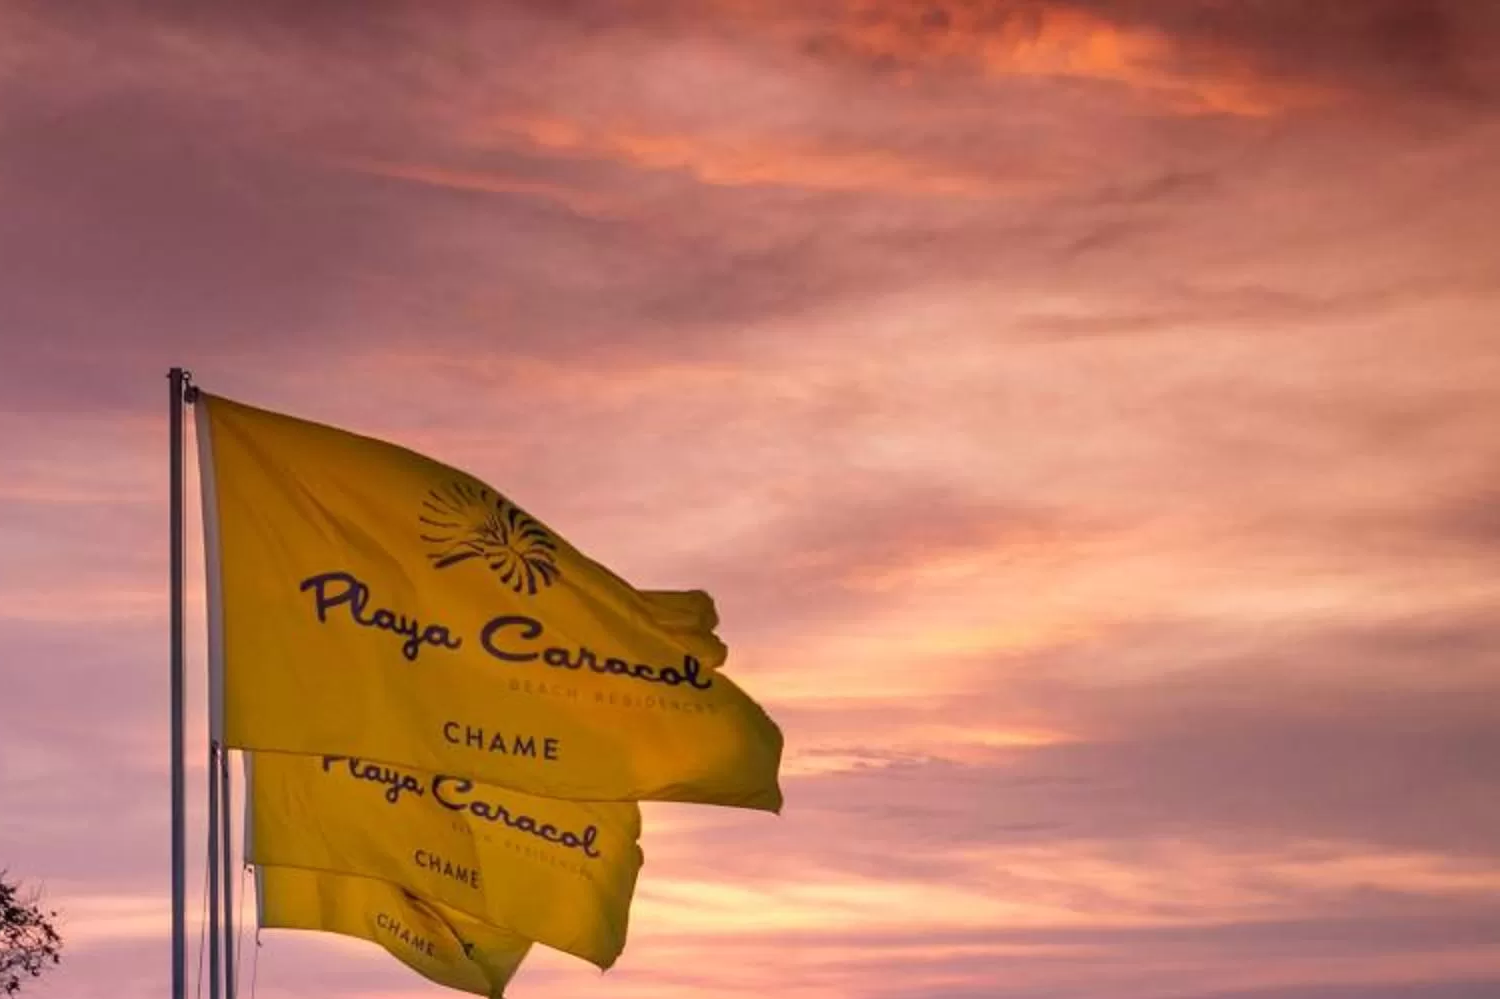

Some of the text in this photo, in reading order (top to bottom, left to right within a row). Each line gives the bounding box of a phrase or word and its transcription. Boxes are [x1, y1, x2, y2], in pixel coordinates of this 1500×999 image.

[301, 572, 713, 690] Playa Caracol
[508, 678, 578, 699] BEACH
[443, 721, 560, 762] CHAME
[432, 774, 600, 858] Caracol
[414, 849, 480, 890] CHAME
[376, 913, 436, 958] CHAME
